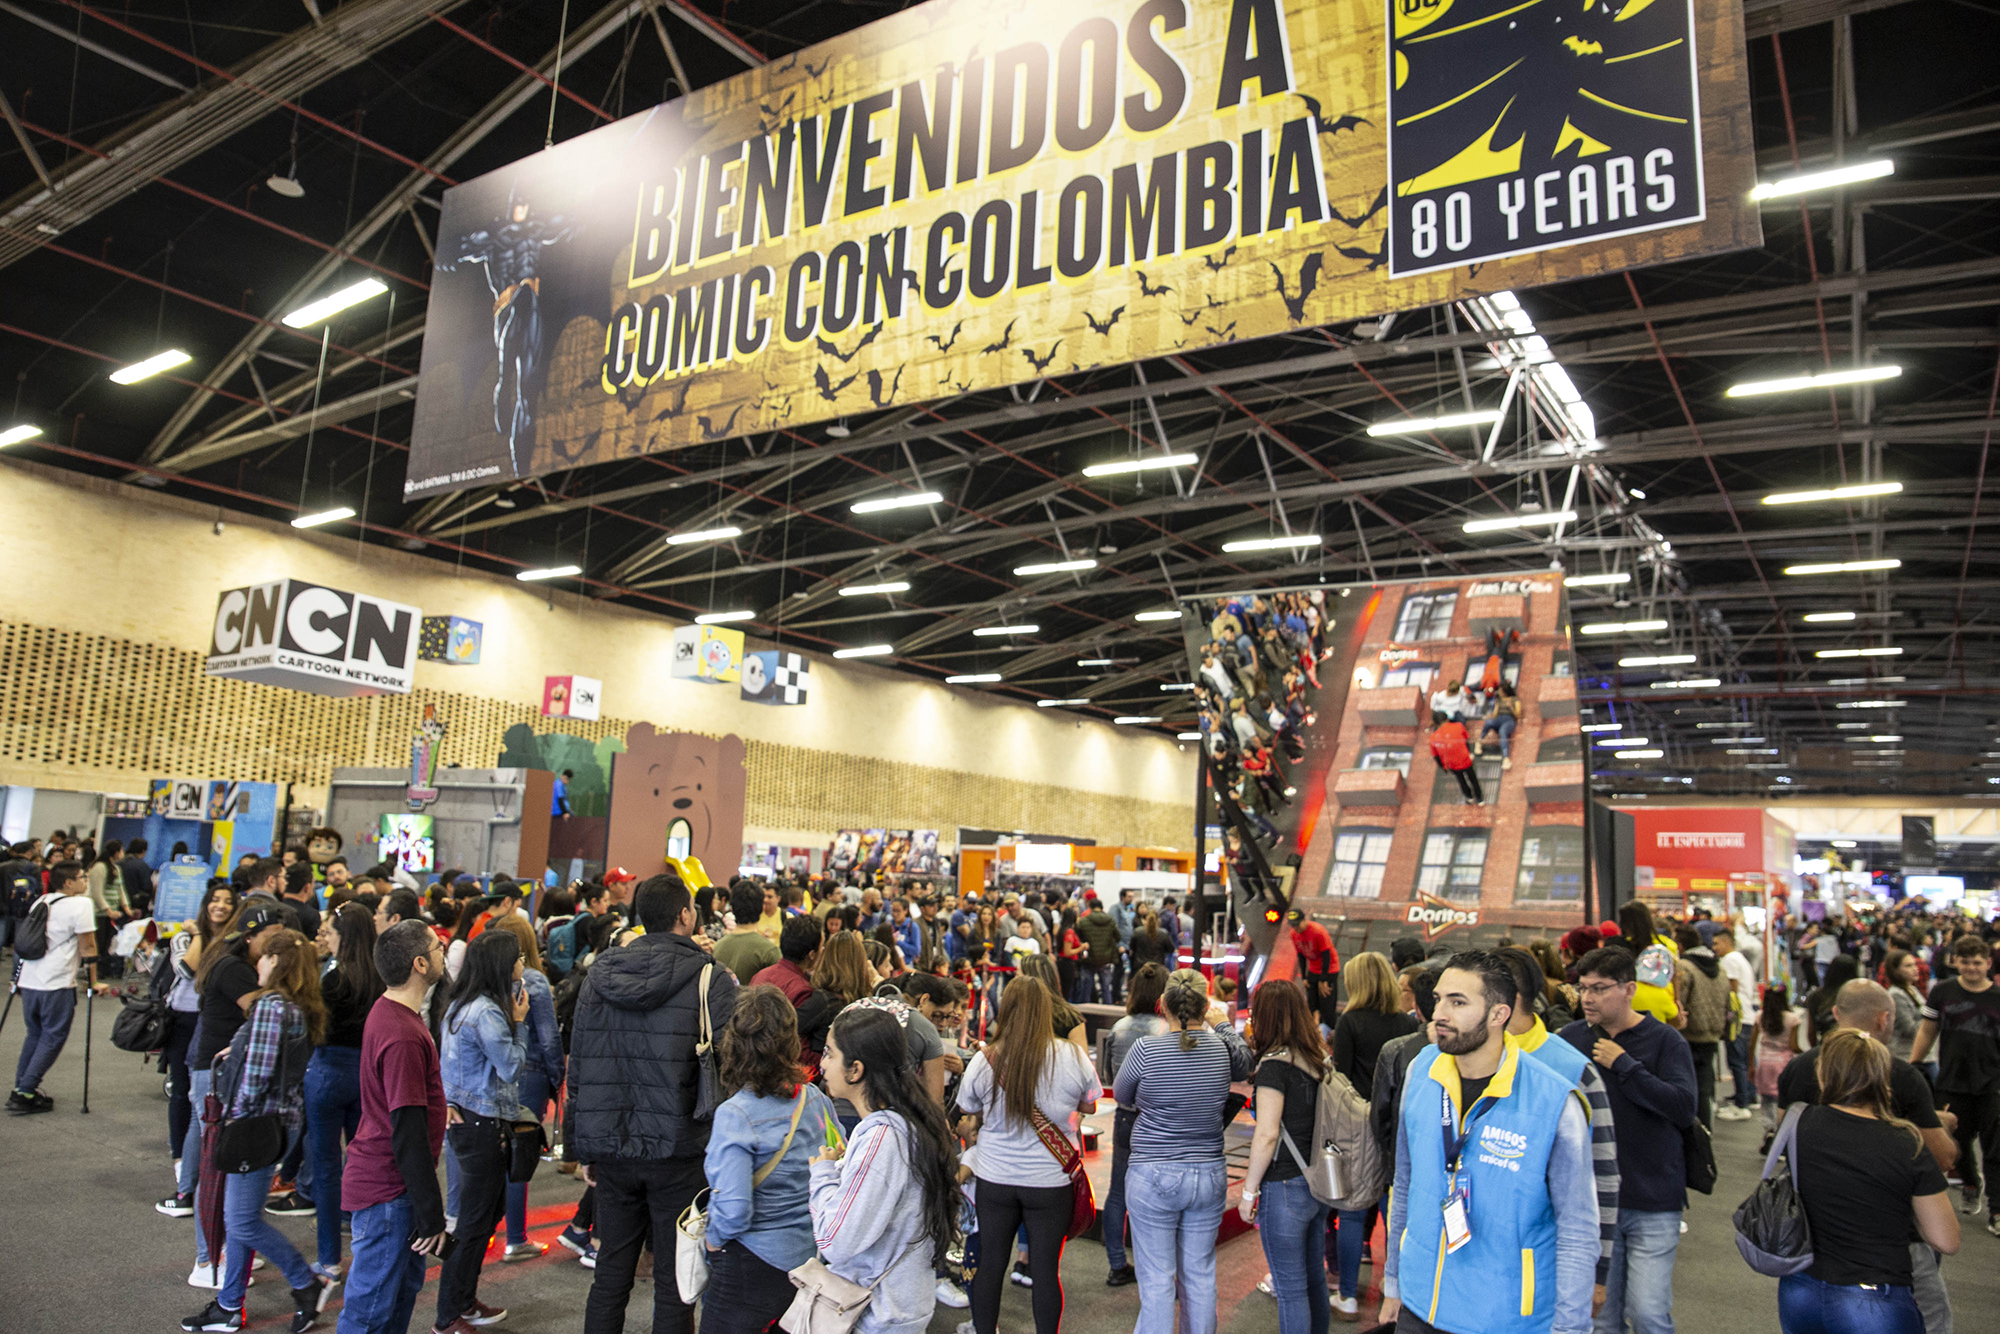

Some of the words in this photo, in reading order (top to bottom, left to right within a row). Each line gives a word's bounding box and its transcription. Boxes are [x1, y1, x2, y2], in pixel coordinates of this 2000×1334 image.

[628, 0, 1191, 288] BIENVENIDOS
[1213, 0, 1296, 117] A
[1412, 191, 1472, 258] 80
[1499, 147, 1676, 241] YEARS
[602, 263, 775, 395] COMIC
[779, 226, 912, 351] CON
[919, 116, 1331, 316] COLOMBIA
[209, 583, 282, 657] CN
[278, 578, 412, 669] CN
[278, 655, 341, 675] CARTOON
[345, 668, 405, 688] NETWORK
[175, 782, 203, 811] CN
[1408, 906, 1478, 925] Doritos
[1479, 1153, 1509, 1169] unicef
[1480, 1125, 1528, 1150] AMIGOS
